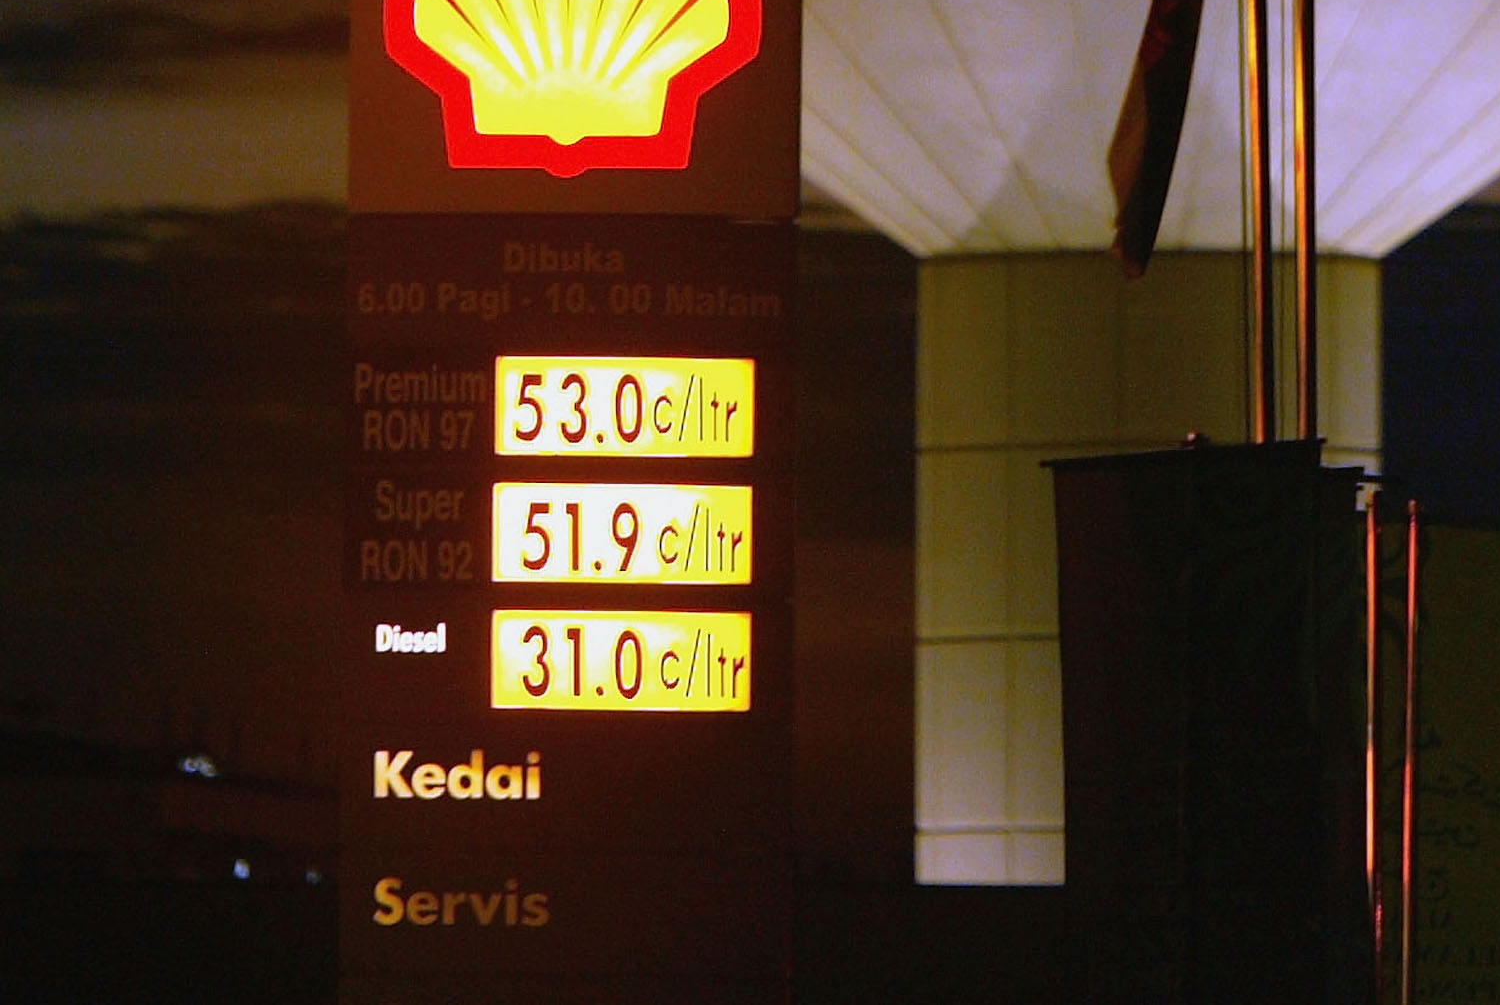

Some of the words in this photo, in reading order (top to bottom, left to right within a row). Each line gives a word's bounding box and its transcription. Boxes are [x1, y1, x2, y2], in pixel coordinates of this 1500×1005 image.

[503, 241, 625, 273] Dibuka
[357, 282, 426, 314] 6.00
[437, 282, 511, 320] Pagi
[664, 284, 782, 318] Malam
[354, 363, 488, 404] Premium
[362, 409, 430, 450] RON
[439, 410, 475, 451] 97
[375, 479, 465, 529] Super
[523, 502, 639, 572] 51.9
[360, 541, 428, 582] RON
[437, 541, 474, 582] 92
[374, 622, 448, 654] Diesel
[522, 626, 643, 699] 31.0
[372, 748, 542, 800] Kedai
[372, 876, 551, 926] Servis
